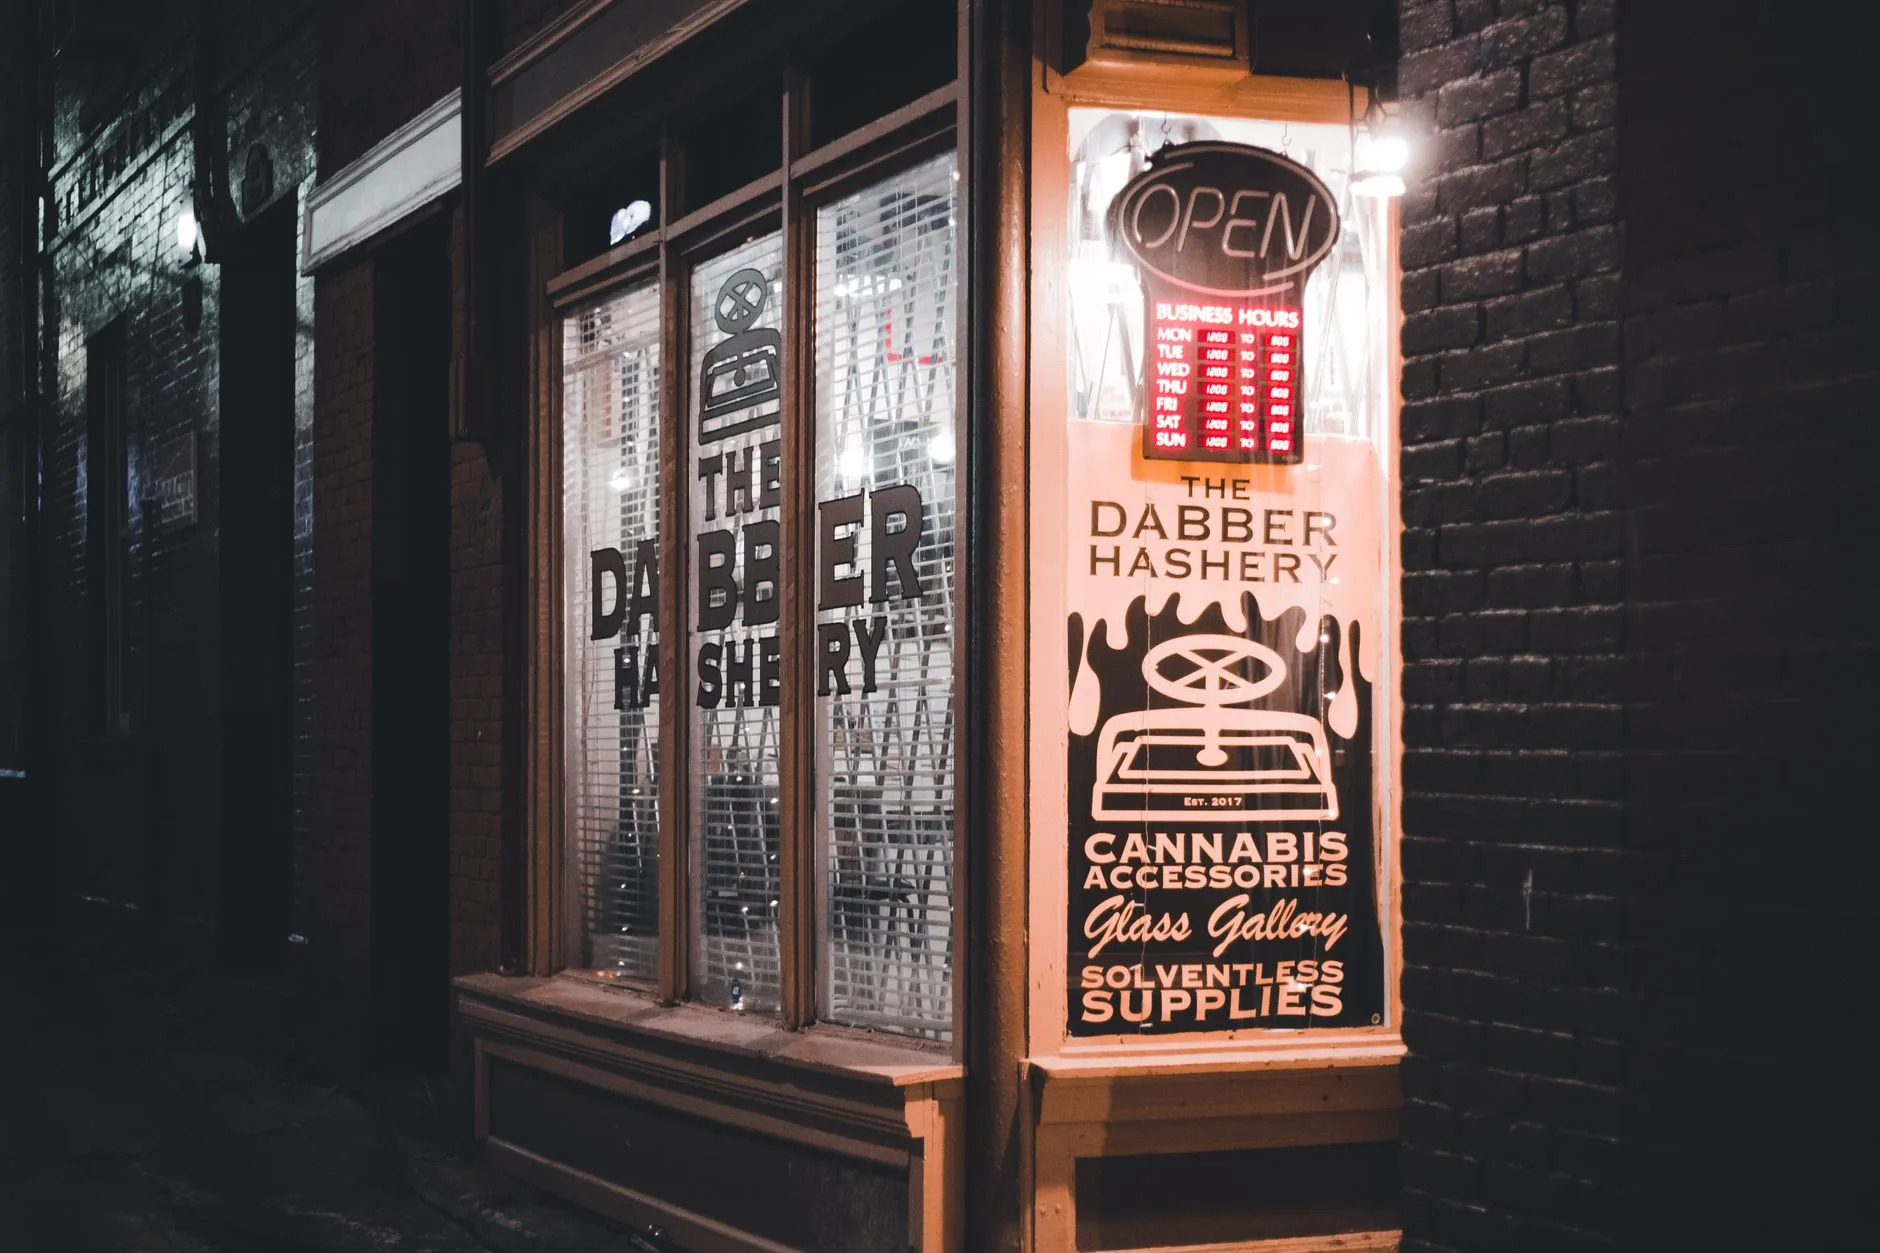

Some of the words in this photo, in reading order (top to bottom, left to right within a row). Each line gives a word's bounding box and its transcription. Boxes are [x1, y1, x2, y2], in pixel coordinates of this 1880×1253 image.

[1133, 184, 1316, 260] OPEN
[1156, 304, 1233, 324] BUSINESS
[1238, 309, 1299, 328] HOURS
[1157, 327, 1192, 342] MON
[1240, 333, 1255, 344] TO
[1157, 344, 1184, 359] TUE
[1240, 350, 1255, 361] TO
[1157, 363, 1190, 377] WED
[1240, 368, 1255, 379] TO
[1157, 380, 1187, 395] THU
[1240, 385, 1255, 396] TO
[1156, 397, 1178, 412] FRI
[1240, 403, 1255, 414] TO
[1156, 415, 1180, 430] SAT
[1240, 420, 1255, 431] TO
[1156, 432, 1186, 448] SUN
[1240, 438, 1255, 449] TO
[699, 439, 780, 521] THE
[1181, 476, 1250, 500] THE
[1090, 500, 1337, 546] DABBER
[1089, 545, 1338, 583] HASHERY
[1211, 797, 1242, 806] 2017
[1084, 832, 1348, 864] CANNABIS
[1083, 864, 1348, 889] ACCESSORIES
[1084, 894, 1192, 959] Glass
[1207, 893, 1348, 957] Gallery
[1081, 960, 1344, 988] SOLVENTLESS
[1081, 984, 1343, 1022] SUPPLIES
